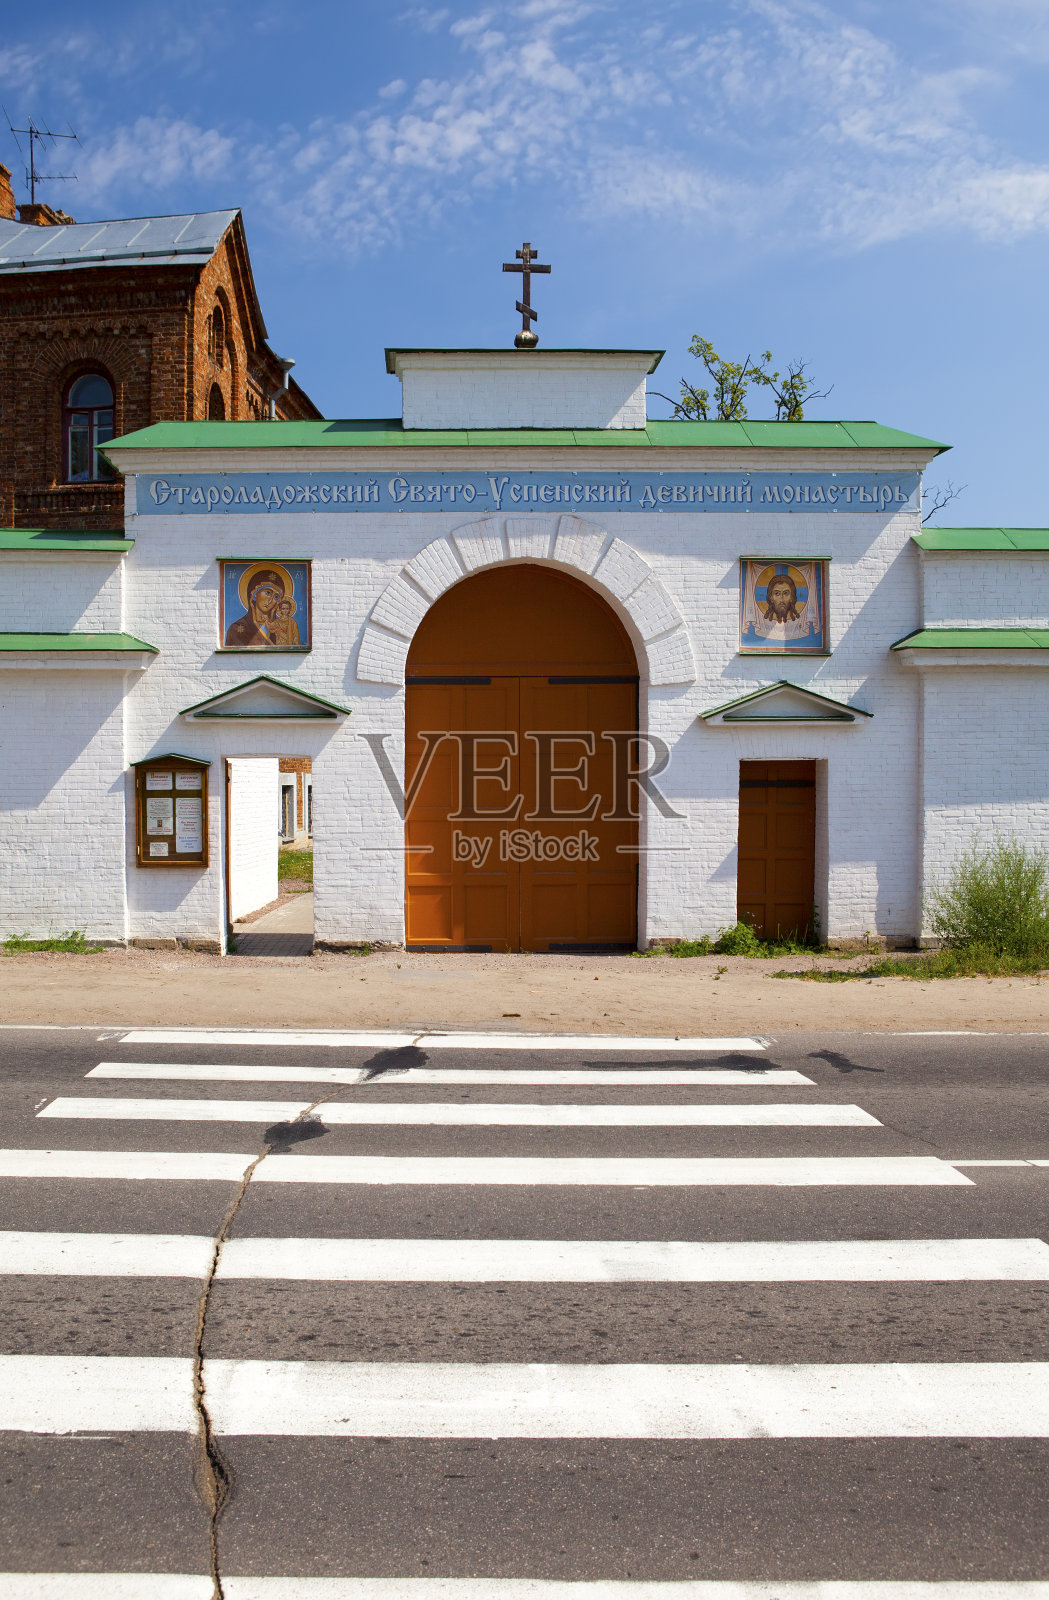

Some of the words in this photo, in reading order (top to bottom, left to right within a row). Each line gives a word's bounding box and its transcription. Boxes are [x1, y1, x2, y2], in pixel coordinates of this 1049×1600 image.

[149, 479, 380, 511] Староладожский
[640, 480, 752, 508] девичий
[760, 484, 909, 510] монастырь
